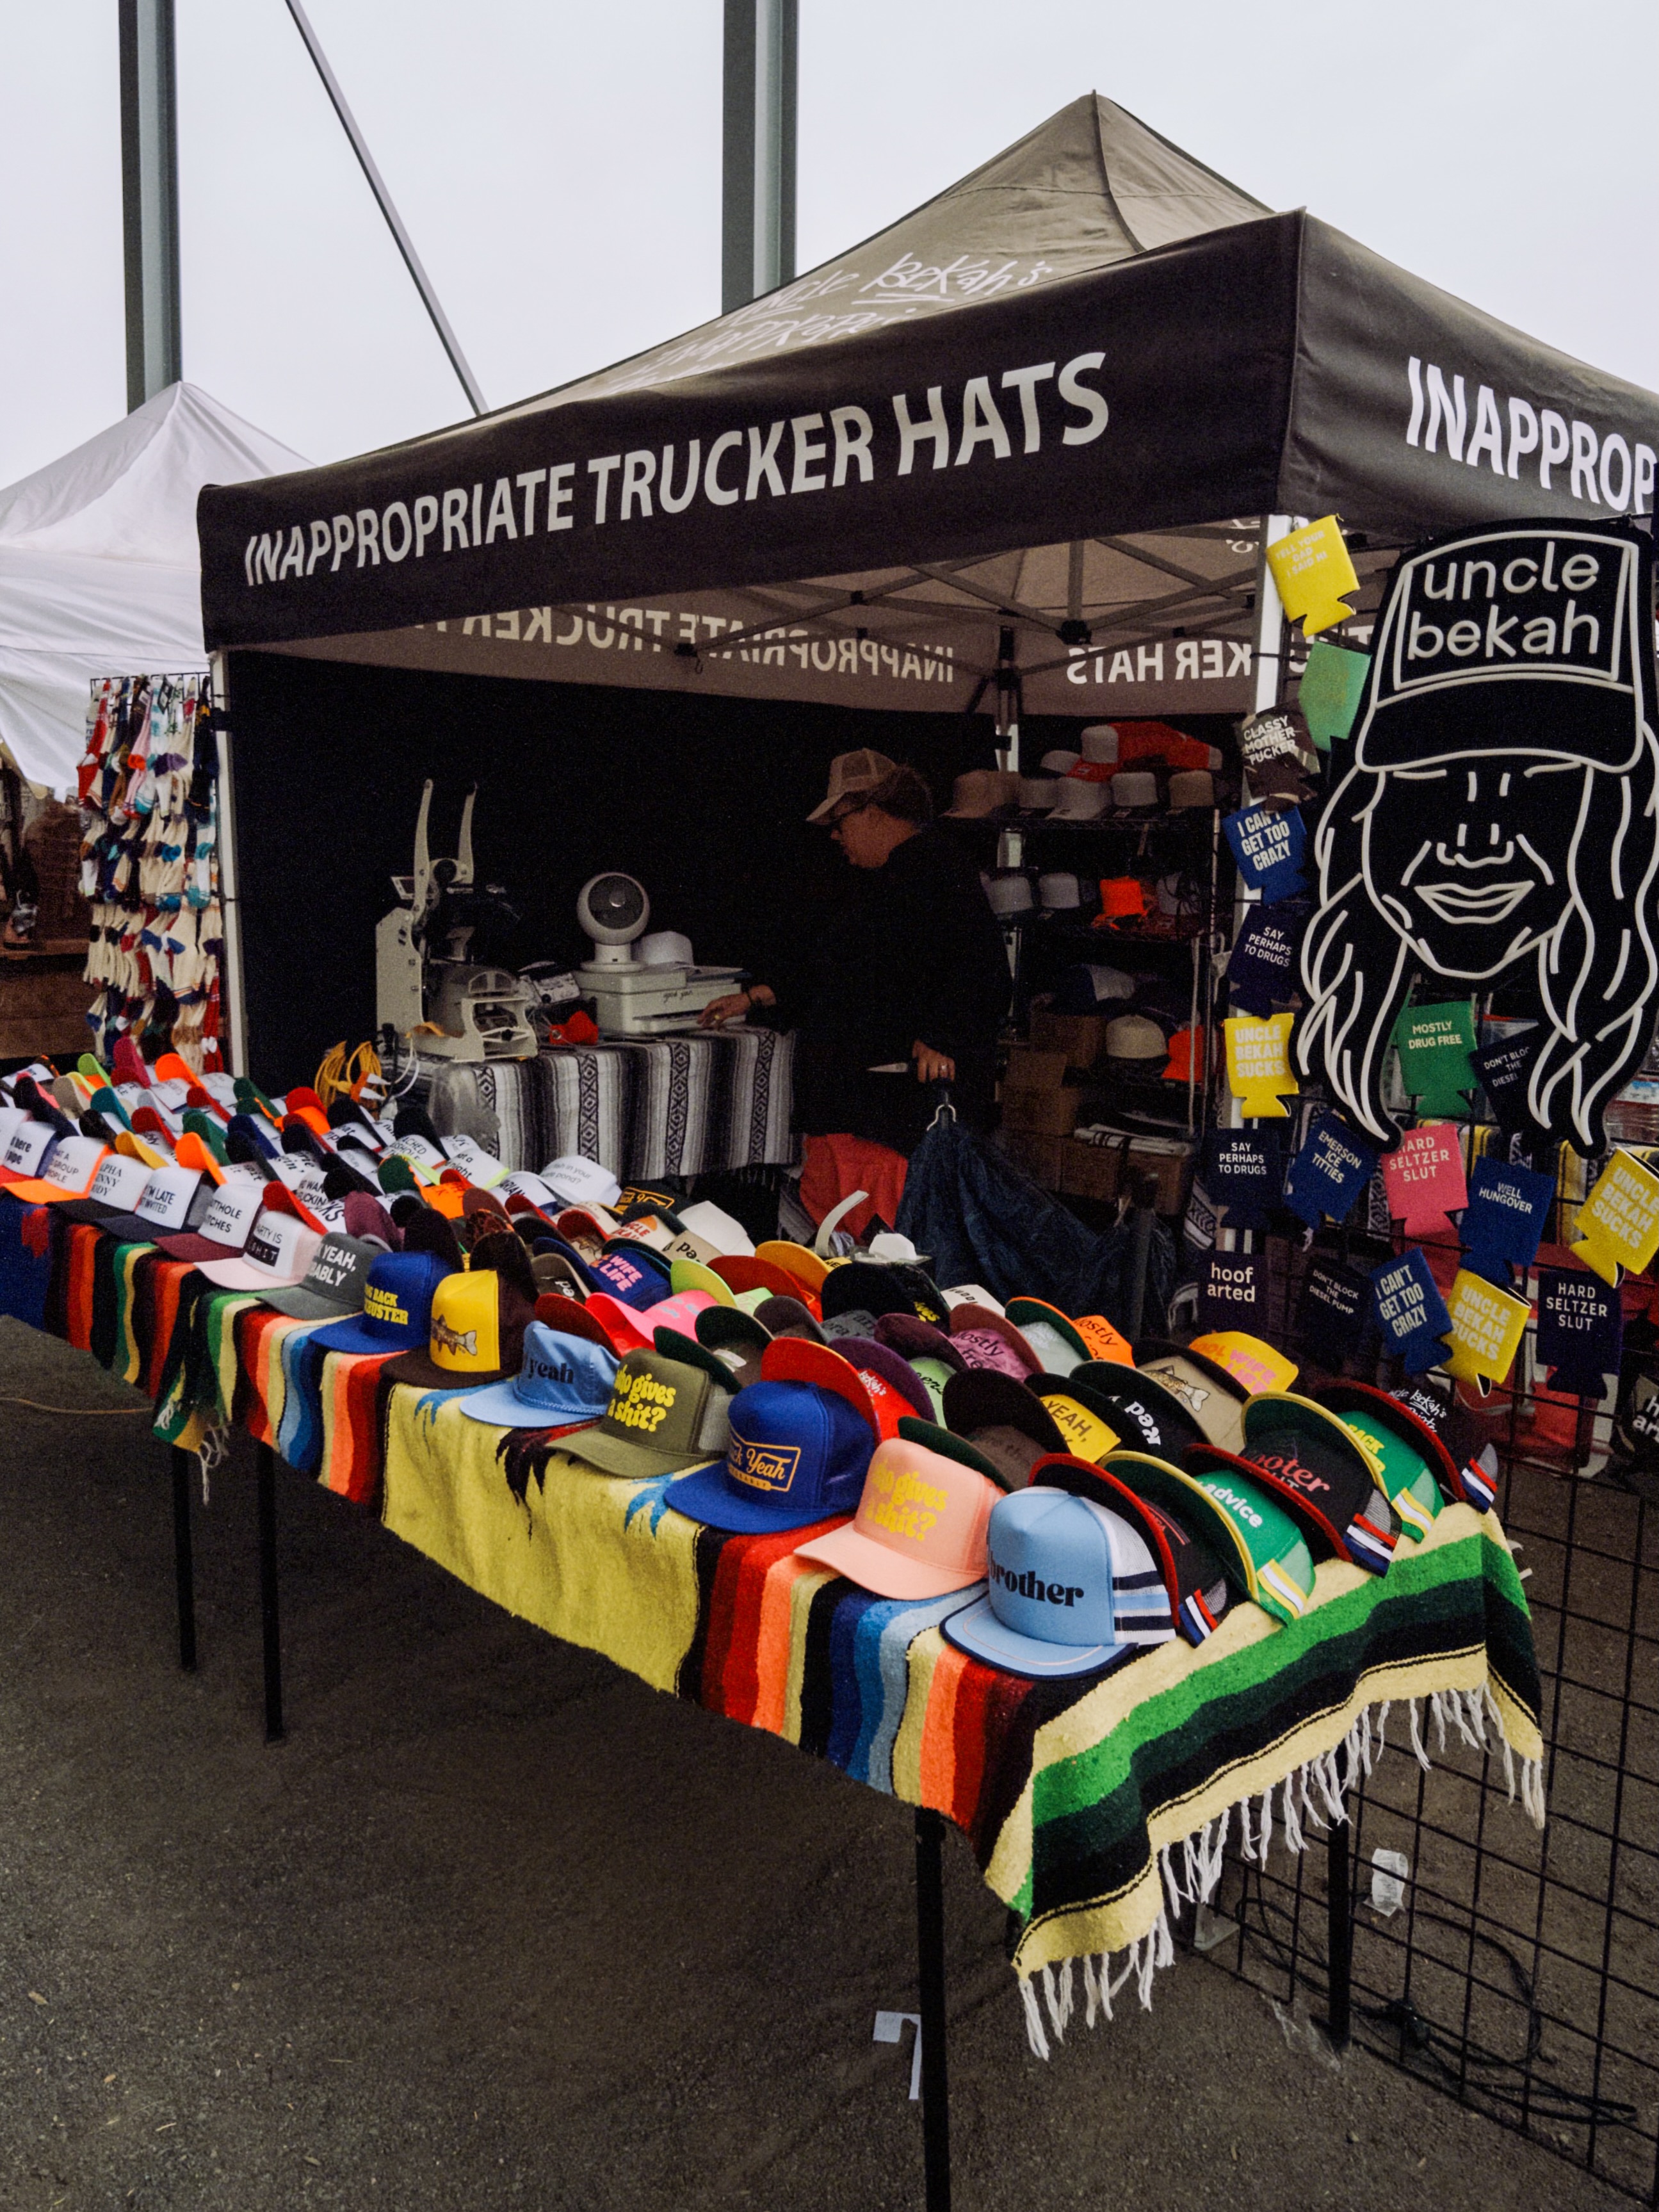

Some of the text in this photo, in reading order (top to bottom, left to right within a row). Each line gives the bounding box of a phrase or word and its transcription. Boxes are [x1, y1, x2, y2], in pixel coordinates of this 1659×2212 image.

[245, 352, 1109, 586] INAPPROPRIATE TRUCKER HATS
[1298, 530, 1325, 547] YOUR
[1292, 546, 1313, 562] DAD
[1424, 541, 1599, 601] uncle
[1408, 599, 1599, 660] bekah
[1243, 715, 1288, 741] CLASSY
[1245, 726, 1296, 754] MOTHER
[1249, 739, 1297, 765] FUCKER
[1237, 810, 1281, 838] I CAN
[1241, 820, 1290, 856] GET TOO
[1252, 840, 1291, 871] CRAZY
[1249, 933, 1292, 956] PERHAPS
[1263, 927, 1284, 940] SAY
[1244, 944, 1290, 967] TO DRUGS
[1235, 1025, 1281, 1043] UNCLE
[1412, 1020, 1453, 1035] MOSTLY
[1235, 1041, 1283, 1061] BEKAH
[1408, 1034, 1463, 1050] DRUG FREE
[1236, 1060, 1285, 1078] SUCKS
[1484, 1054, 1509, 1070] DON'T
[1231, 1142, 1252, 1152] SAY
[1318, 1130, 1362, 1169] EMERSON
[1398, 1137, 1435, 1153] ARD
[1218, 1165, 1267, 1175] TO DRUGS
[1219, 1153, 1265, 1164] PERHAPS
[1313, 1153, 1345, 1184] TITTIES
[1325, 1150, 1343, 1167] ICE
[1389, 1150, 1450, 1171] SELTZER
[1403, 1165, 1437, 1182] SLUT
[155, 1188, 176, 1205] LATE
[1478, 1187, 1533, 1214] HUNGOVER
[1497, 1182, 1522, 1200] WELL
[1601, 1182, 1654, 1233] BEKAH
[1592, 1200, 1643, 1249] SUCKS
[272, 1232, 283, 1244] IS
[322, 1244, 357, 1272] YEAH,
[610, 1255, 643, 1283] WIFE
[309, 1262, 348, 1287] ABLY
[599, 1263, 633, 1292] LIFE
[1211, 1262, 1254, 1284] hoof
[1313, 1269, 1359, 1300] DON'T BLOCK
[1375, 1264, 1414, 1300] I CAN'T
[373, 1288, 398, 1307] BACK
[1207, 1282, 1256, 1303] arted
[1327, 1285, 1339, 1299] THE
[1379, 1283, 1424, 1320] GET TOO
[1558, 1282, 1596, 1299] HARD
[1332, 1299, 1354, 1314] PUMP
[1461, 1285, 1511, 1327] UNCLE
[1546, 1296, 1608, 1317] SELTZER
[1392, 1304, 1427, 1337] CRAZY
[1453, 1300, 1505, 1344] BEKAH
[1558, 1313, 1593, 1331] SLUT
[528, 1358, 574, 1384] yeah
[629, 1373, 677, 1408] gives
[615, 1400, 667, 1433] shit?
[747, 1448, 792, 1480] Yeah
[891, 1470, 948, 1513] gives
[1203, 1483, 1263, 1529] advice
[875, 1501, 937, 1541] shit?
